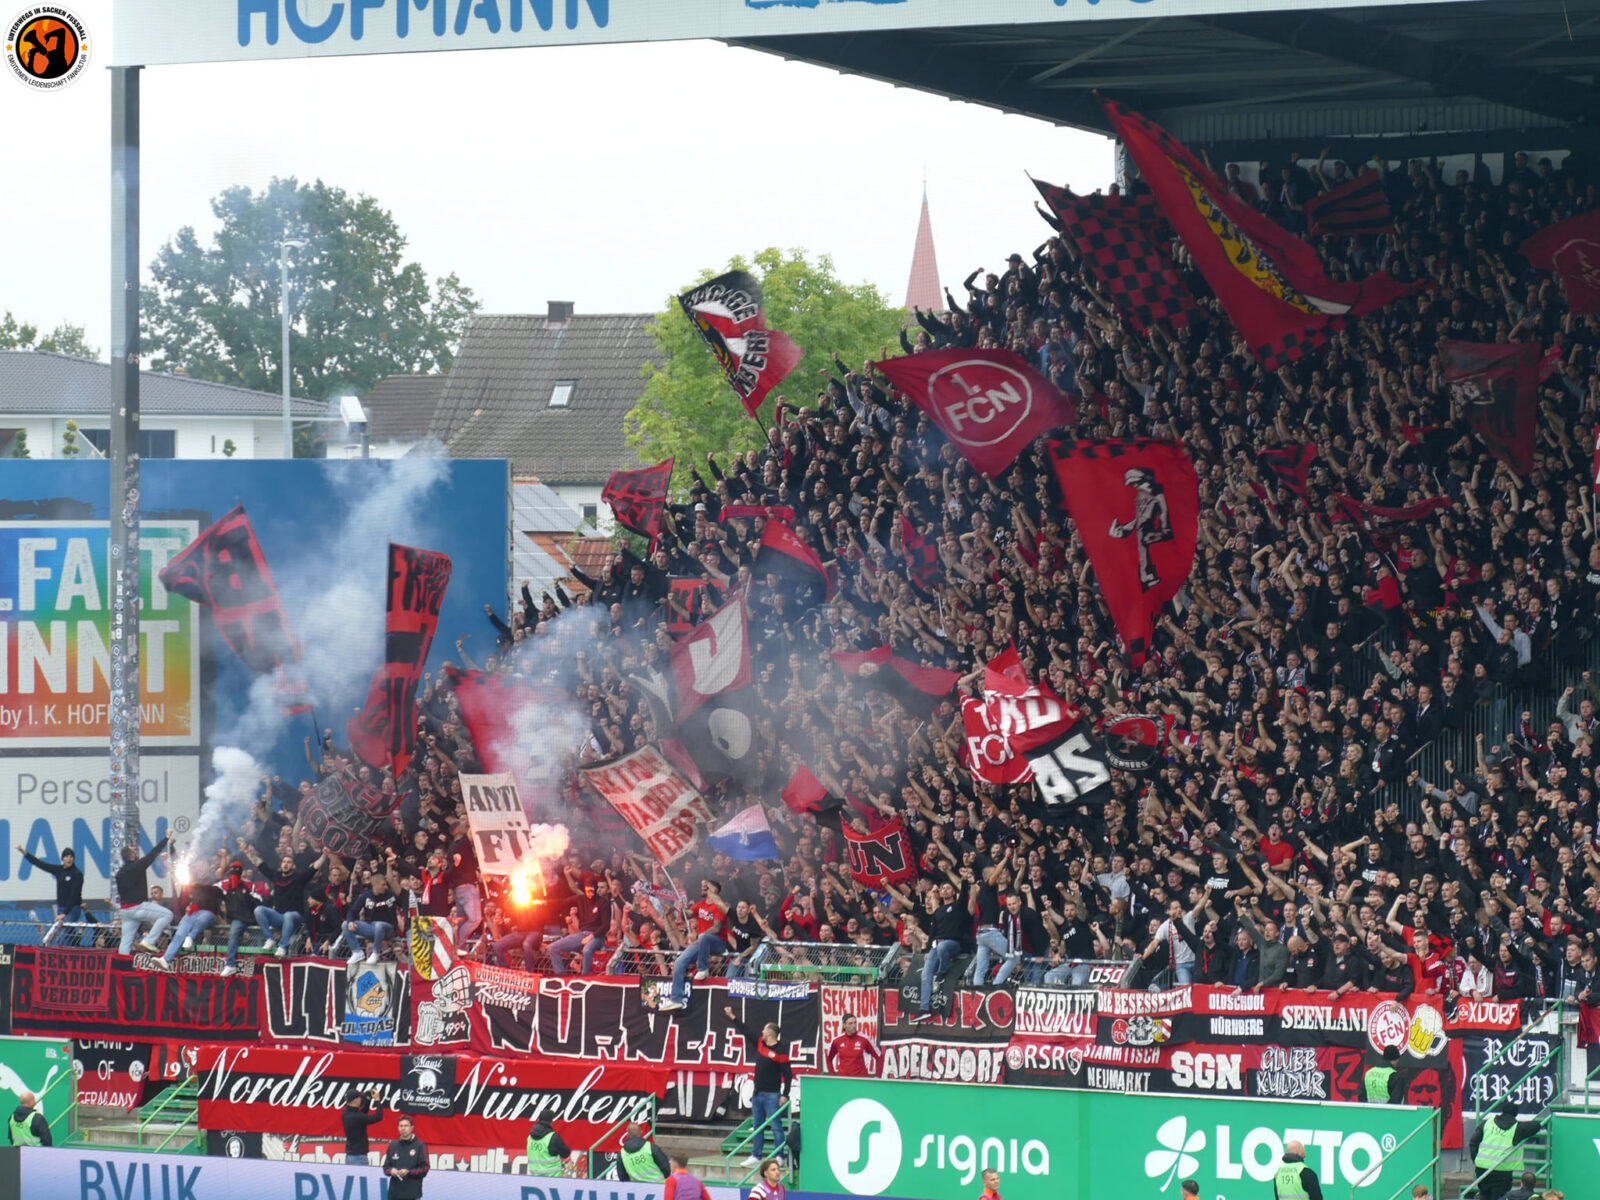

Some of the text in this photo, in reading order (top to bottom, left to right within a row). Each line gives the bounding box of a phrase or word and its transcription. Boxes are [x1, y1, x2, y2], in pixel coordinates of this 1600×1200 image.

[944, 380, 1022, 432] FCN
[45, 704, 61, 725] K.
[469, 785, 522, 812] ANTI
[39, 952, 108, 970] SEKTION
[39, 969, 105, 987] STADION
[40, 986, 102, 1004] VERBOT
[822, 987, 878, 1018] SEKTION
[1114, 986, 1193, 1015] BESESSENEN
[1209, 993, 1265, 1011] OLDSCHOOL
[341, 1019, 394, 1036] ULTRAS
[1210, 1016, 1264, 1035] NÜRNBERG
[97, 1060, 114, 1080] OF
[881, 1043, 1004, 1083] ADELSDORF
[1024, 1044, 1066, 1070] RSR
[1171, 1050, 1242, 1090] SGN
[1087, 1066, 1151, 1092] NEUMARKT
[914, 1134, 1050, 1186] signia
[1216, 1125, 1383, 1188] LOTTO
[1281, 1174, 1295, 1186] 191
